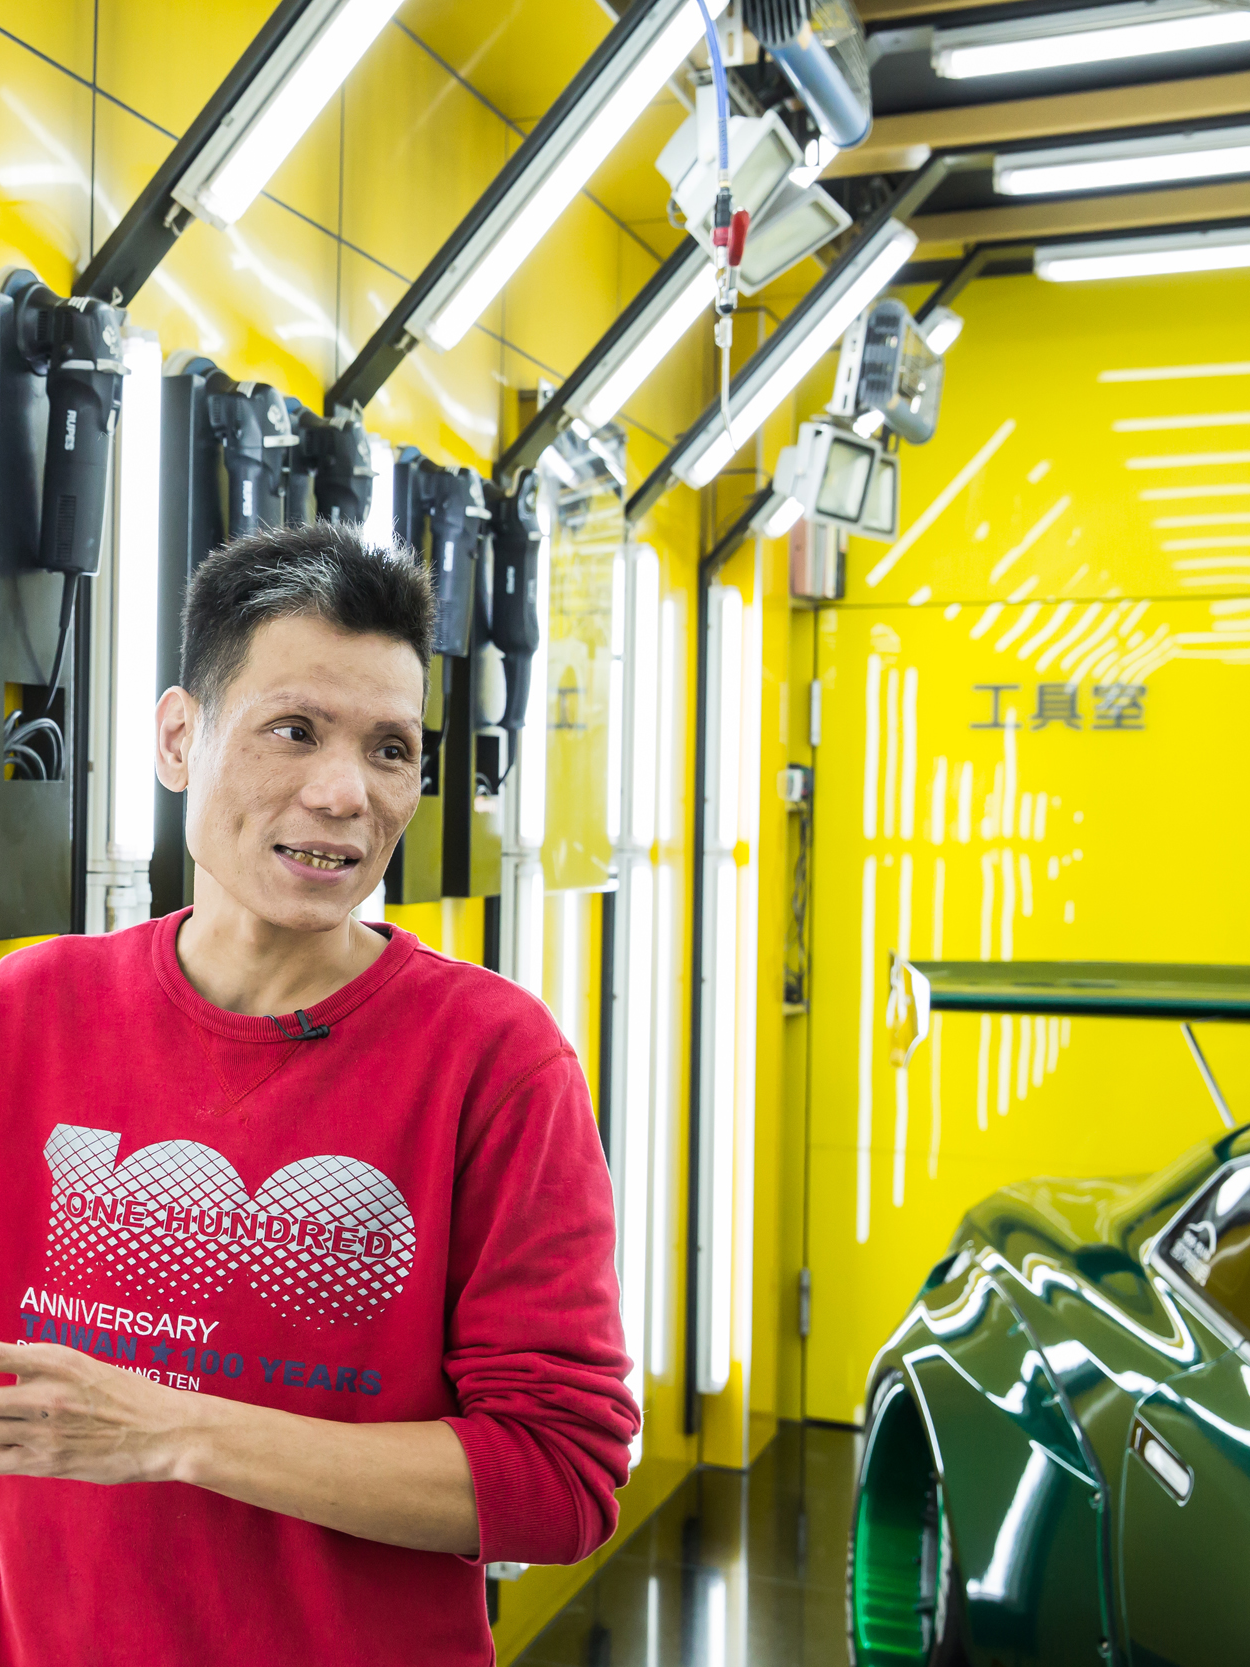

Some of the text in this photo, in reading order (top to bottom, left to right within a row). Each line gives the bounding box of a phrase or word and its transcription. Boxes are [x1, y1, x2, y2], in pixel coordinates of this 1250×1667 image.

[64, 409, 77, 451] RUPES
[969, 682, 1147, 732] 工具室
[64, 1191, 396, 1261] ONE HUNDRED
[20, 1287, 219, 1344] ANNIVERSARY
[20, 1312, 382, 1396] TAIWAN 100 YEARS
[115, 1364, 200, 1391] NG TEN
